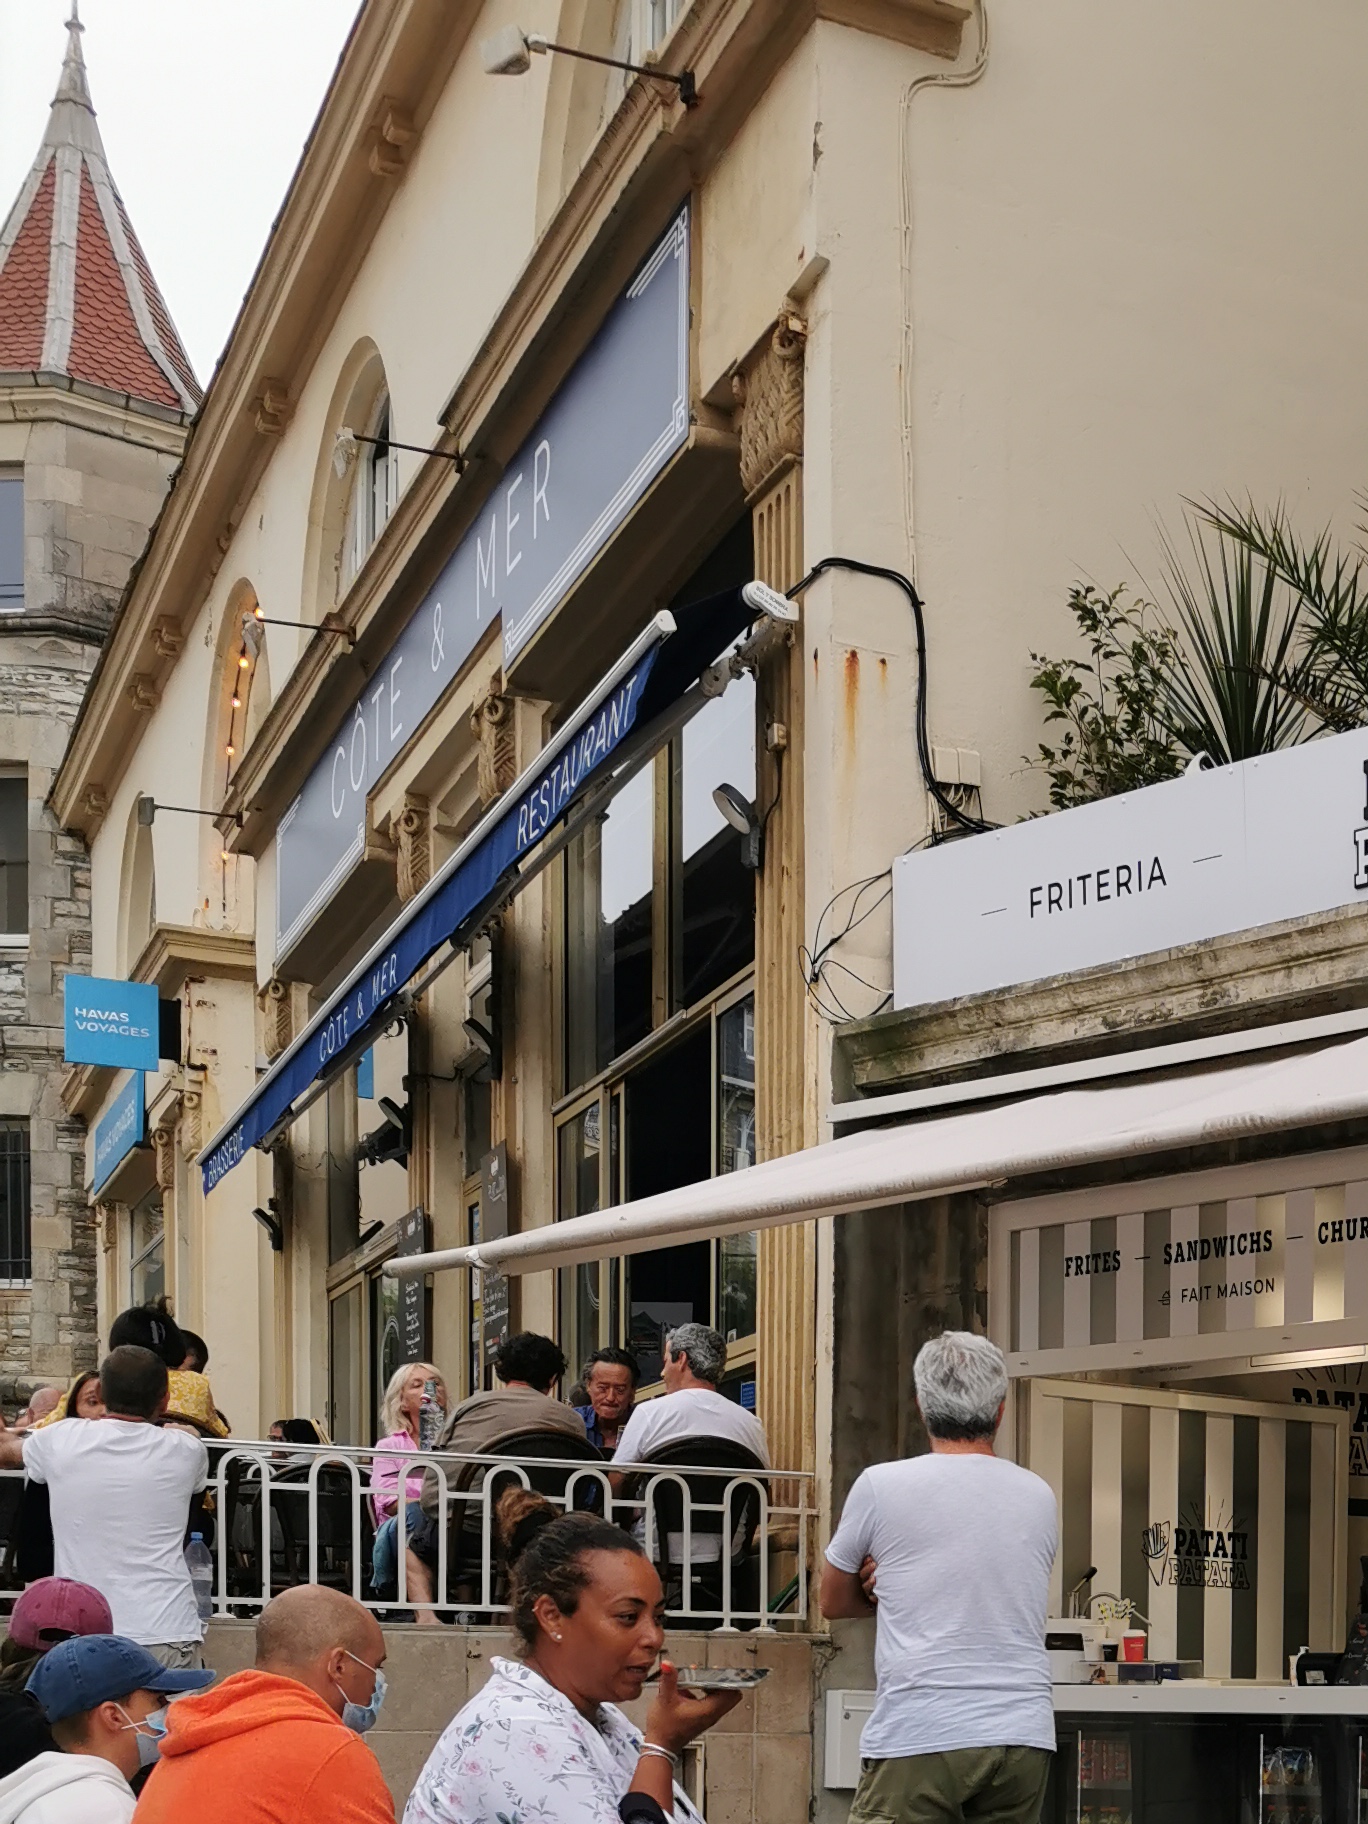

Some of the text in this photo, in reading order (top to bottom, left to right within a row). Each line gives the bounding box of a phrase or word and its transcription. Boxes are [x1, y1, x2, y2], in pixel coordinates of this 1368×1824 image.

[331, 439, 552, 819] CÔTE & MER
[516, 674, 638, 851] RESTAURANT
[1029, 855, 1168, 919] FRITERIA
[74, 1006, 130, 1023] HAVAS
[75, 1020, 150, 1038] VOYAGES
[318, 953, 398, 1062] CÔTE & MER
[207, 1123, 246, 1188] BRASSERIE
[1064, 1250, 1121, 1277] FRITES
[1163, 1230, 1273, 1265] SANDWICHS
[1181, 1278, 1275, 1304] FAIT MAISON
[1174, 1527, 1248, 1560] PATATI
[1168, 1557, 1251, 1590] PATATA
